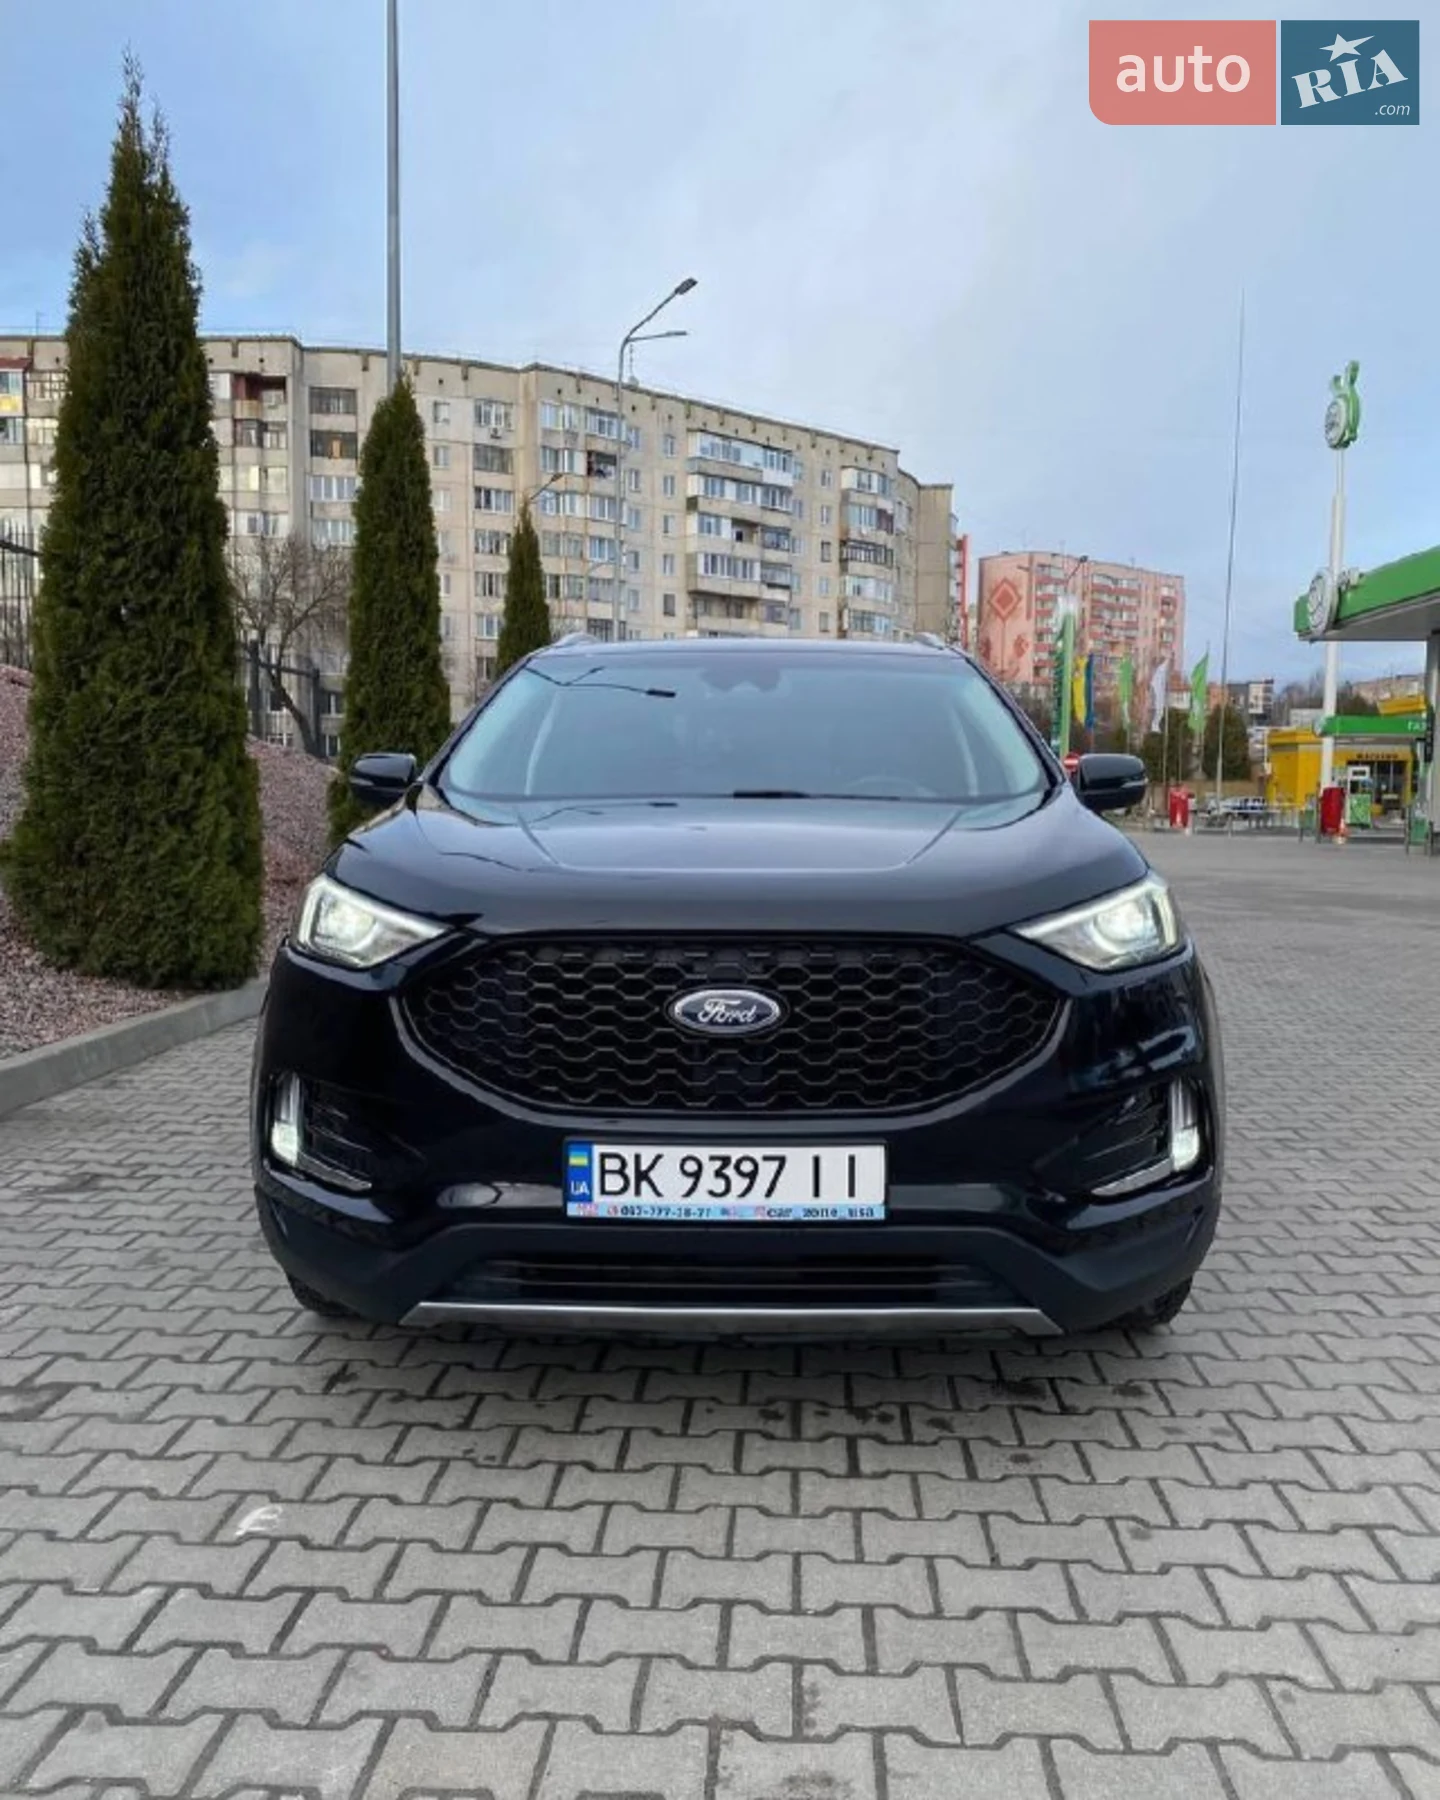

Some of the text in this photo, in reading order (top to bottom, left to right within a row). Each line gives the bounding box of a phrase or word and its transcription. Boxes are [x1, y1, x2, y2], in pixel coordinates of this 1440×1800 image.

[697, 998, 757, 1022] Ford
[599, 1152, 664, 1197] BK
[680, 1154, 787, 1198] 9397
[570, 1180, 590, 1195] UA
